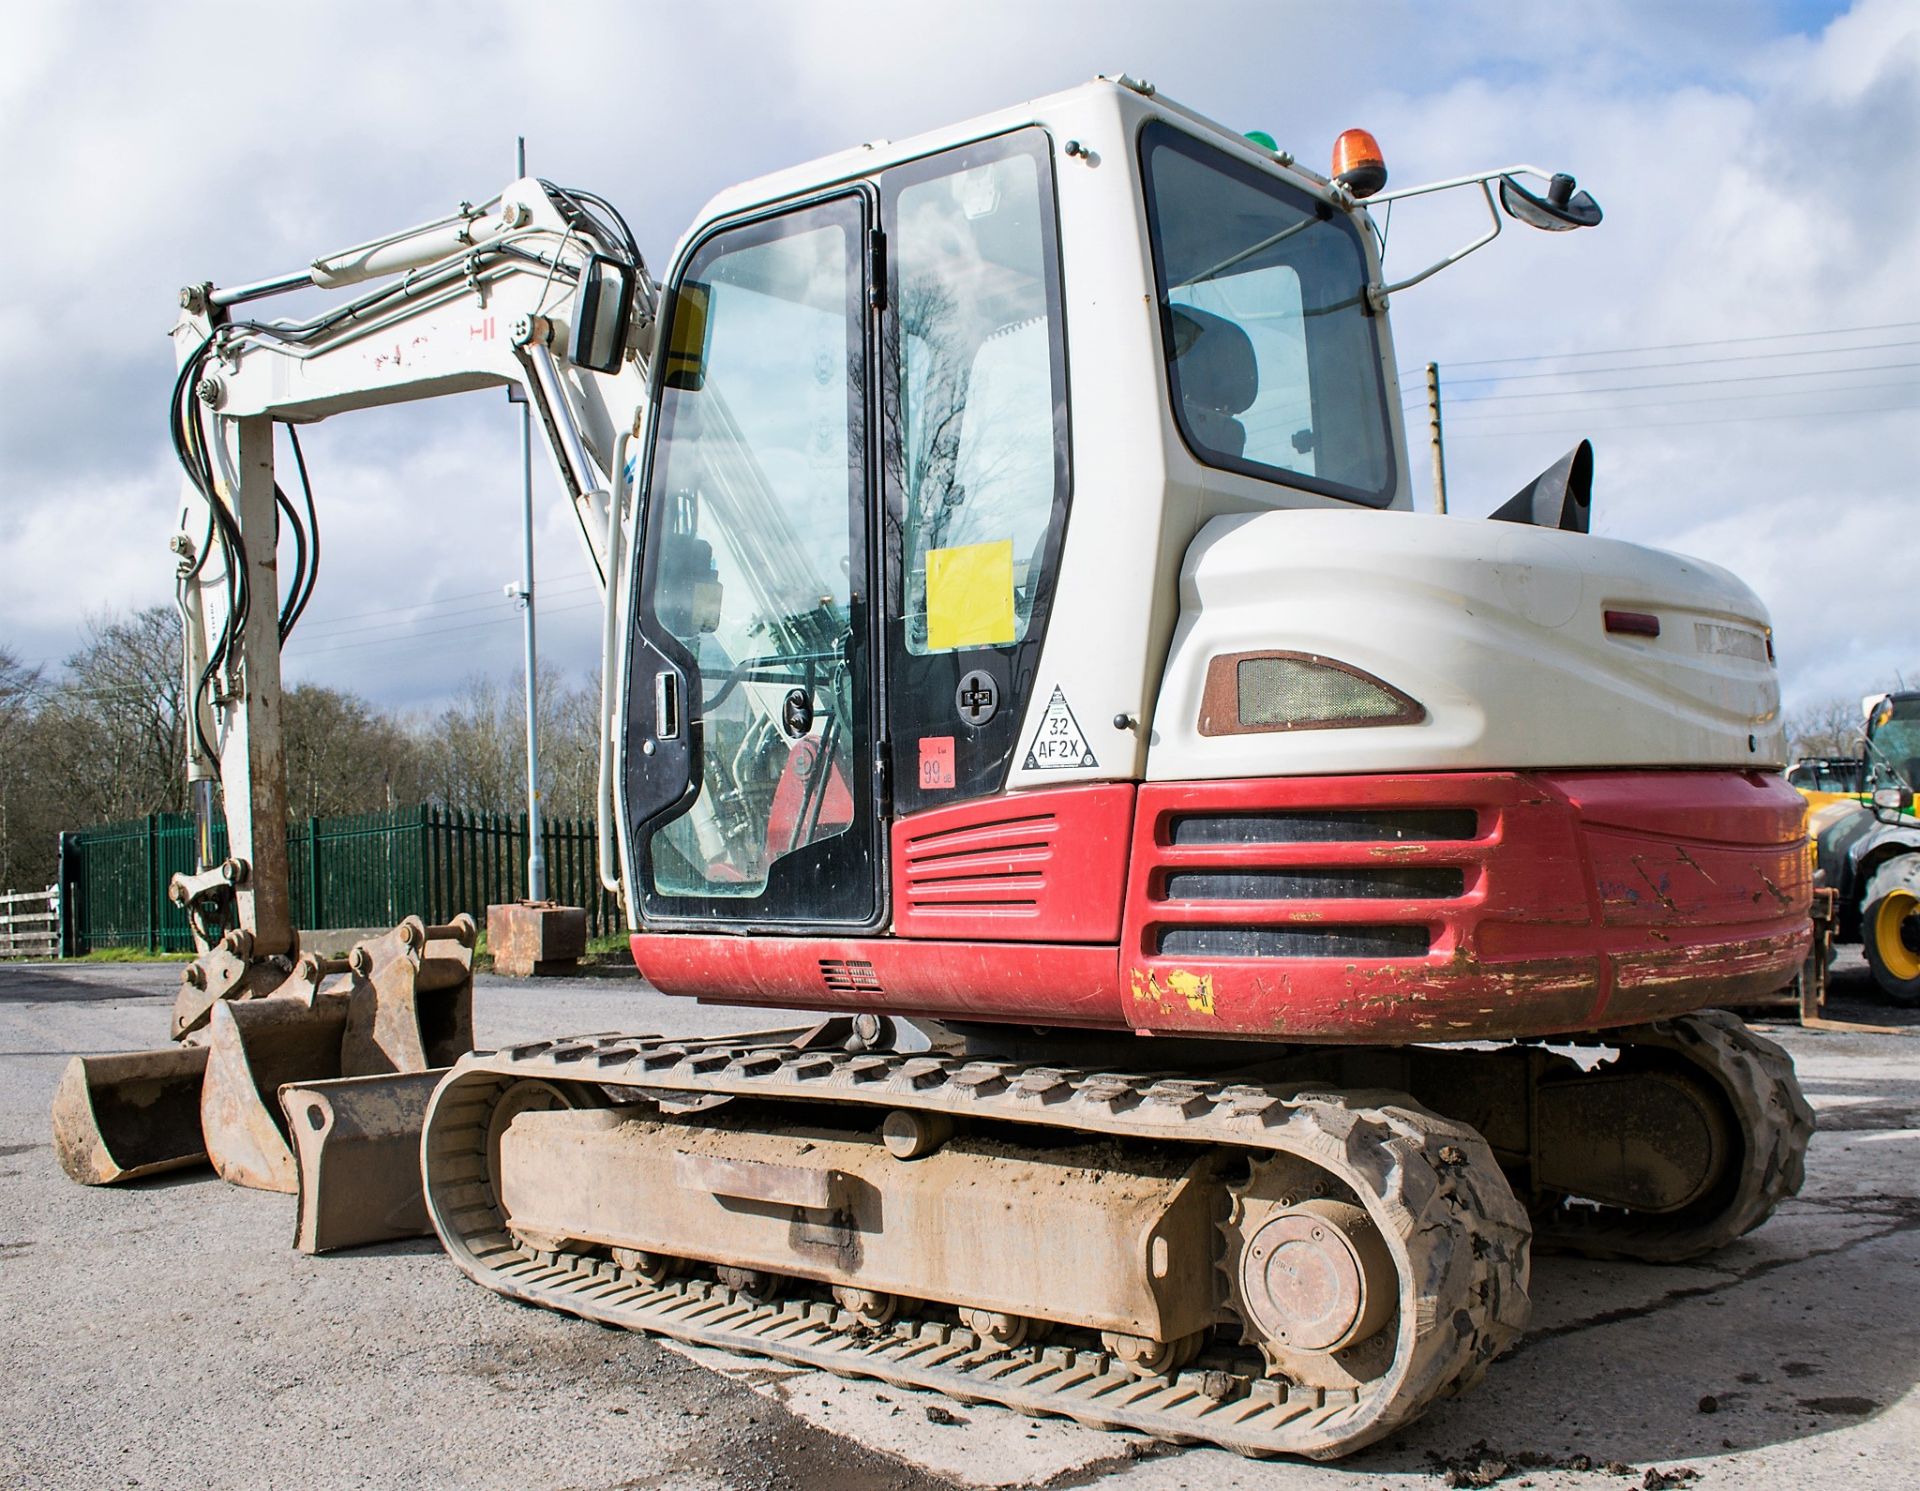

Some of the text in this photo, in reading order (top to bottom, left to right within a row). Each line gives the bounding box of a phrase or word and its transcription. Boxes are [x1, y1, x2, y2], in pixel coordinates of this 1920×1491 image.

[1049, 717, 1069, 736] 32
[1038, 739, 1079, 759] AF2X
[923, 760, 940, 784] 99
